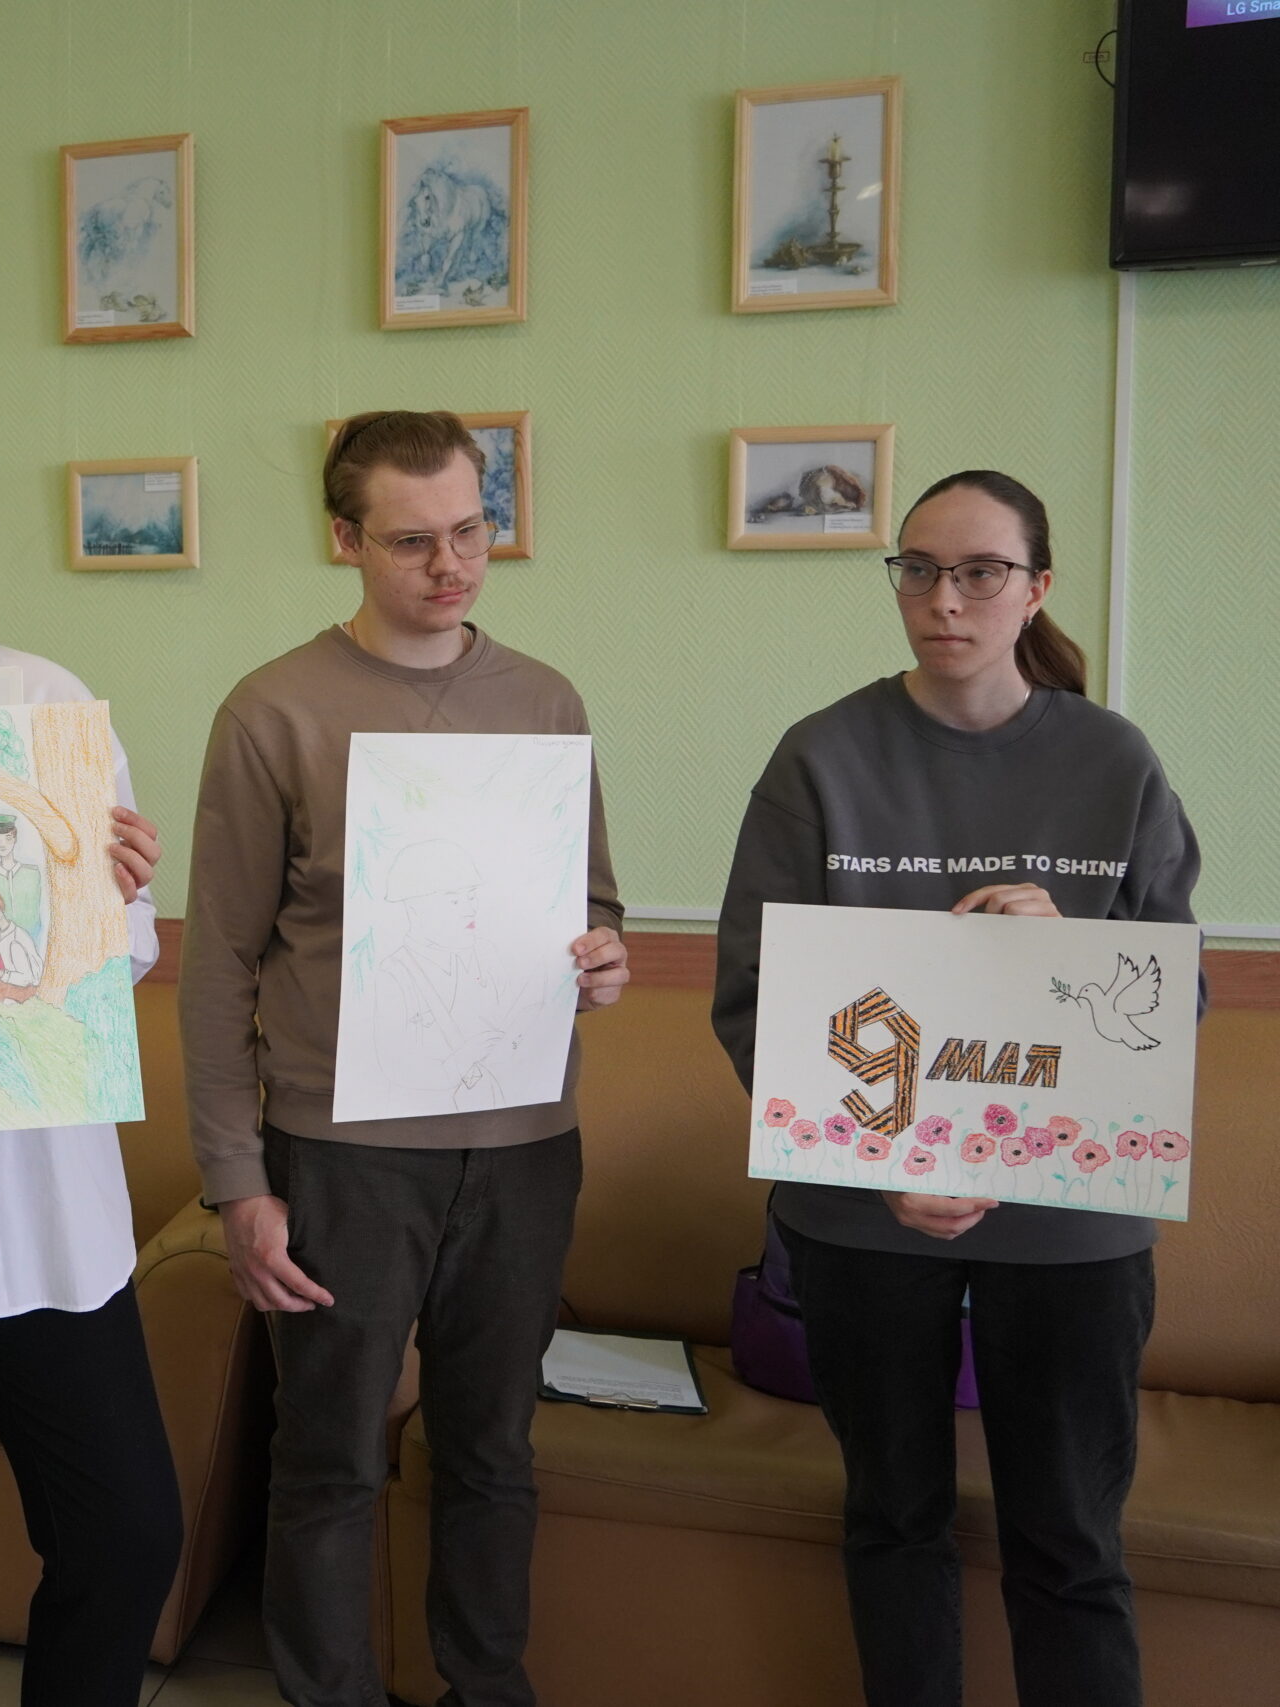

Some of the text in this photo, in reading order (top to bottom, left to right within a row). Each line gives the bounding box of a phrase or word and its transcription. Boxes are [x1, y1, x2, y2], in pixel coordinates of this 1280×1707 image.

[1227, 2, 1246, 15] LG
[826, 854, 1128, 878] STARS ARE MADE TO SHINE
[827, 986, 1062, 1139] 9 МАЯ
